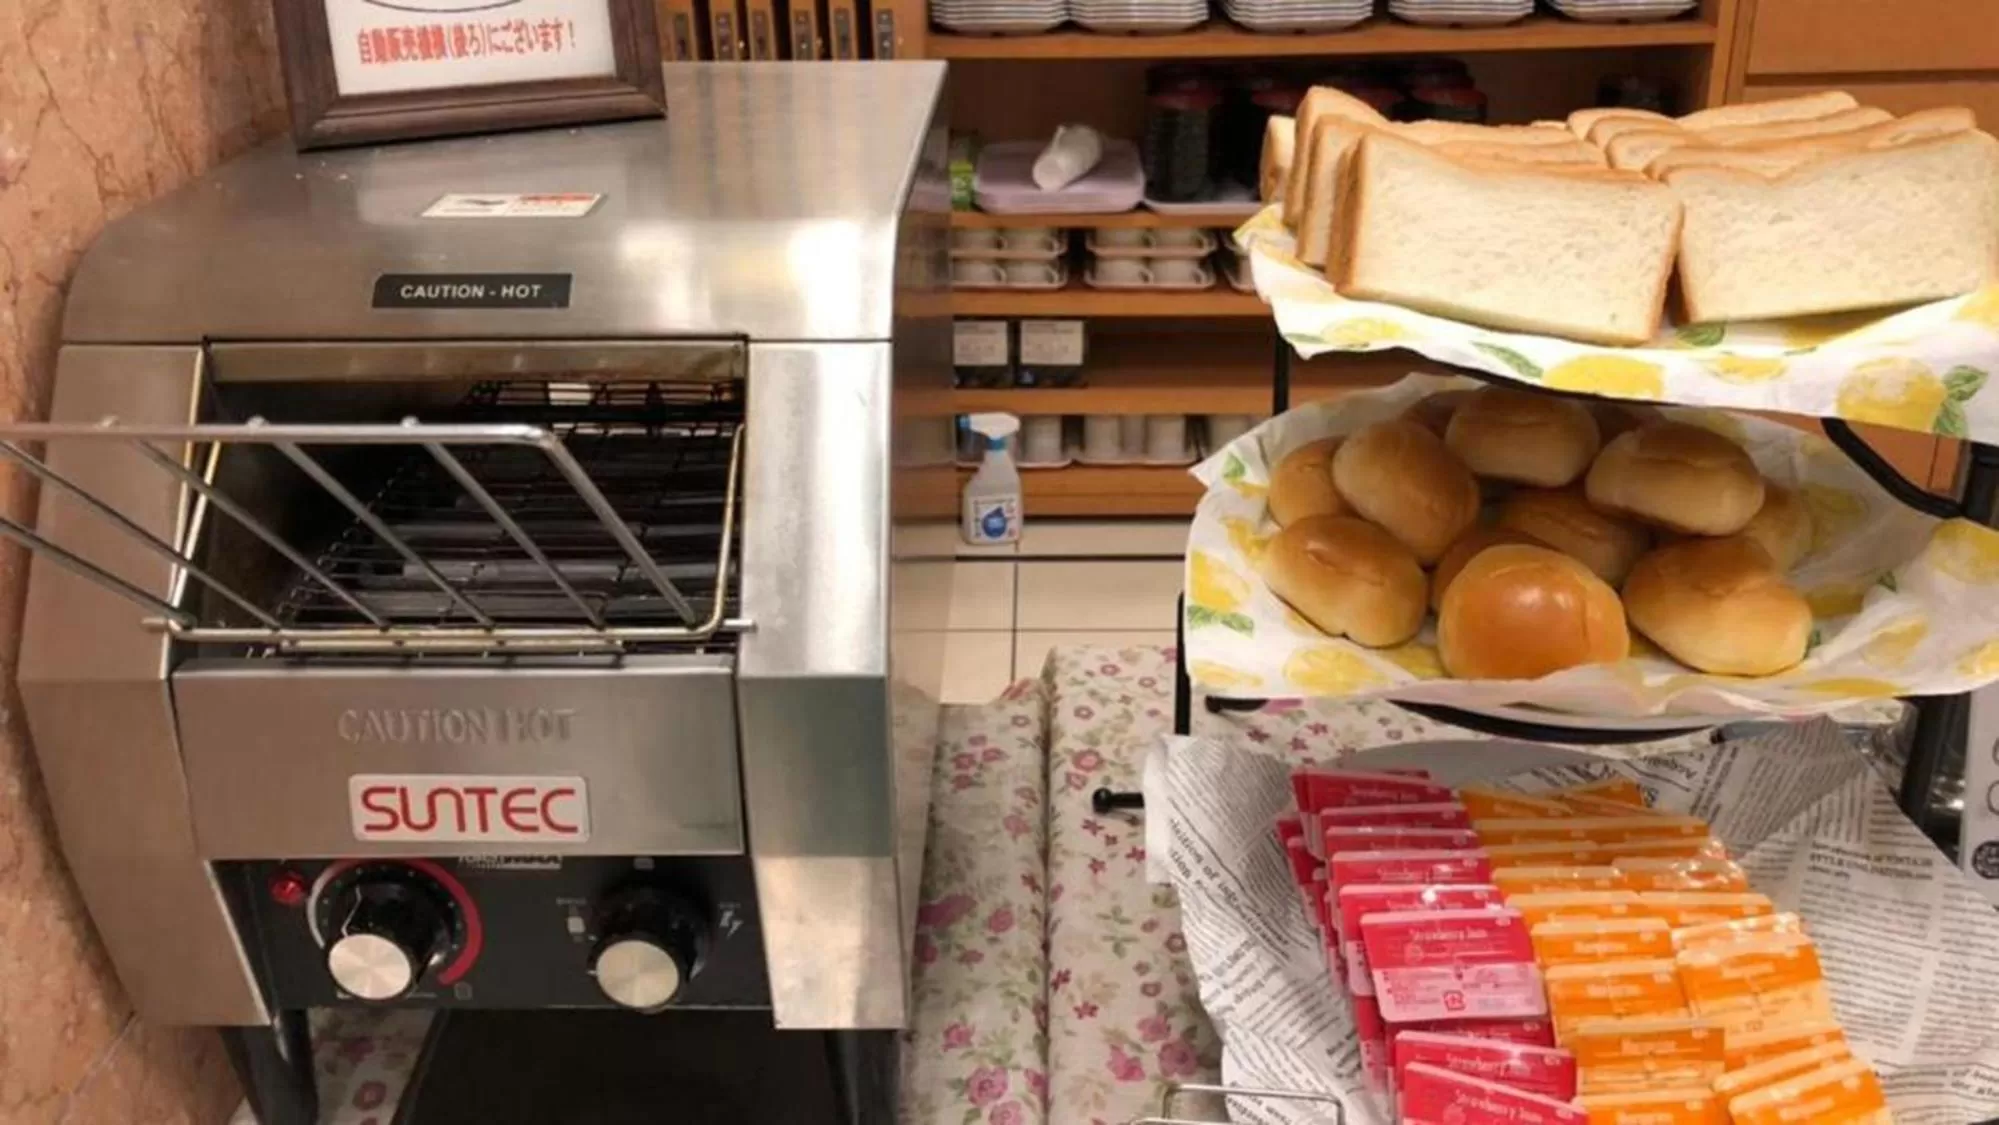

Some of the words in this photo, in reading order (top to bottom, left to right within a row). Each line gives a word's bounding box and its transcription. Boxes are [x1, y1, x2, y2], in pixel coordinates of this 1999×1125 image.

[400, 284, 484, 298] CAUTION
[501, 284, 542, 298] HOT
[337, 707, 497, 744] CAUTION
[504, 707, 577, 742] HOT
[361, 786, 579, 833] SUNTEC
[1409, 926, 1465, 942] Strawberry
[1466, 926, 1488, 939] Jam
[1455, 1088, 1516, 1121] Strawberry
[1519, 1105, 1543, 1123] Jam
